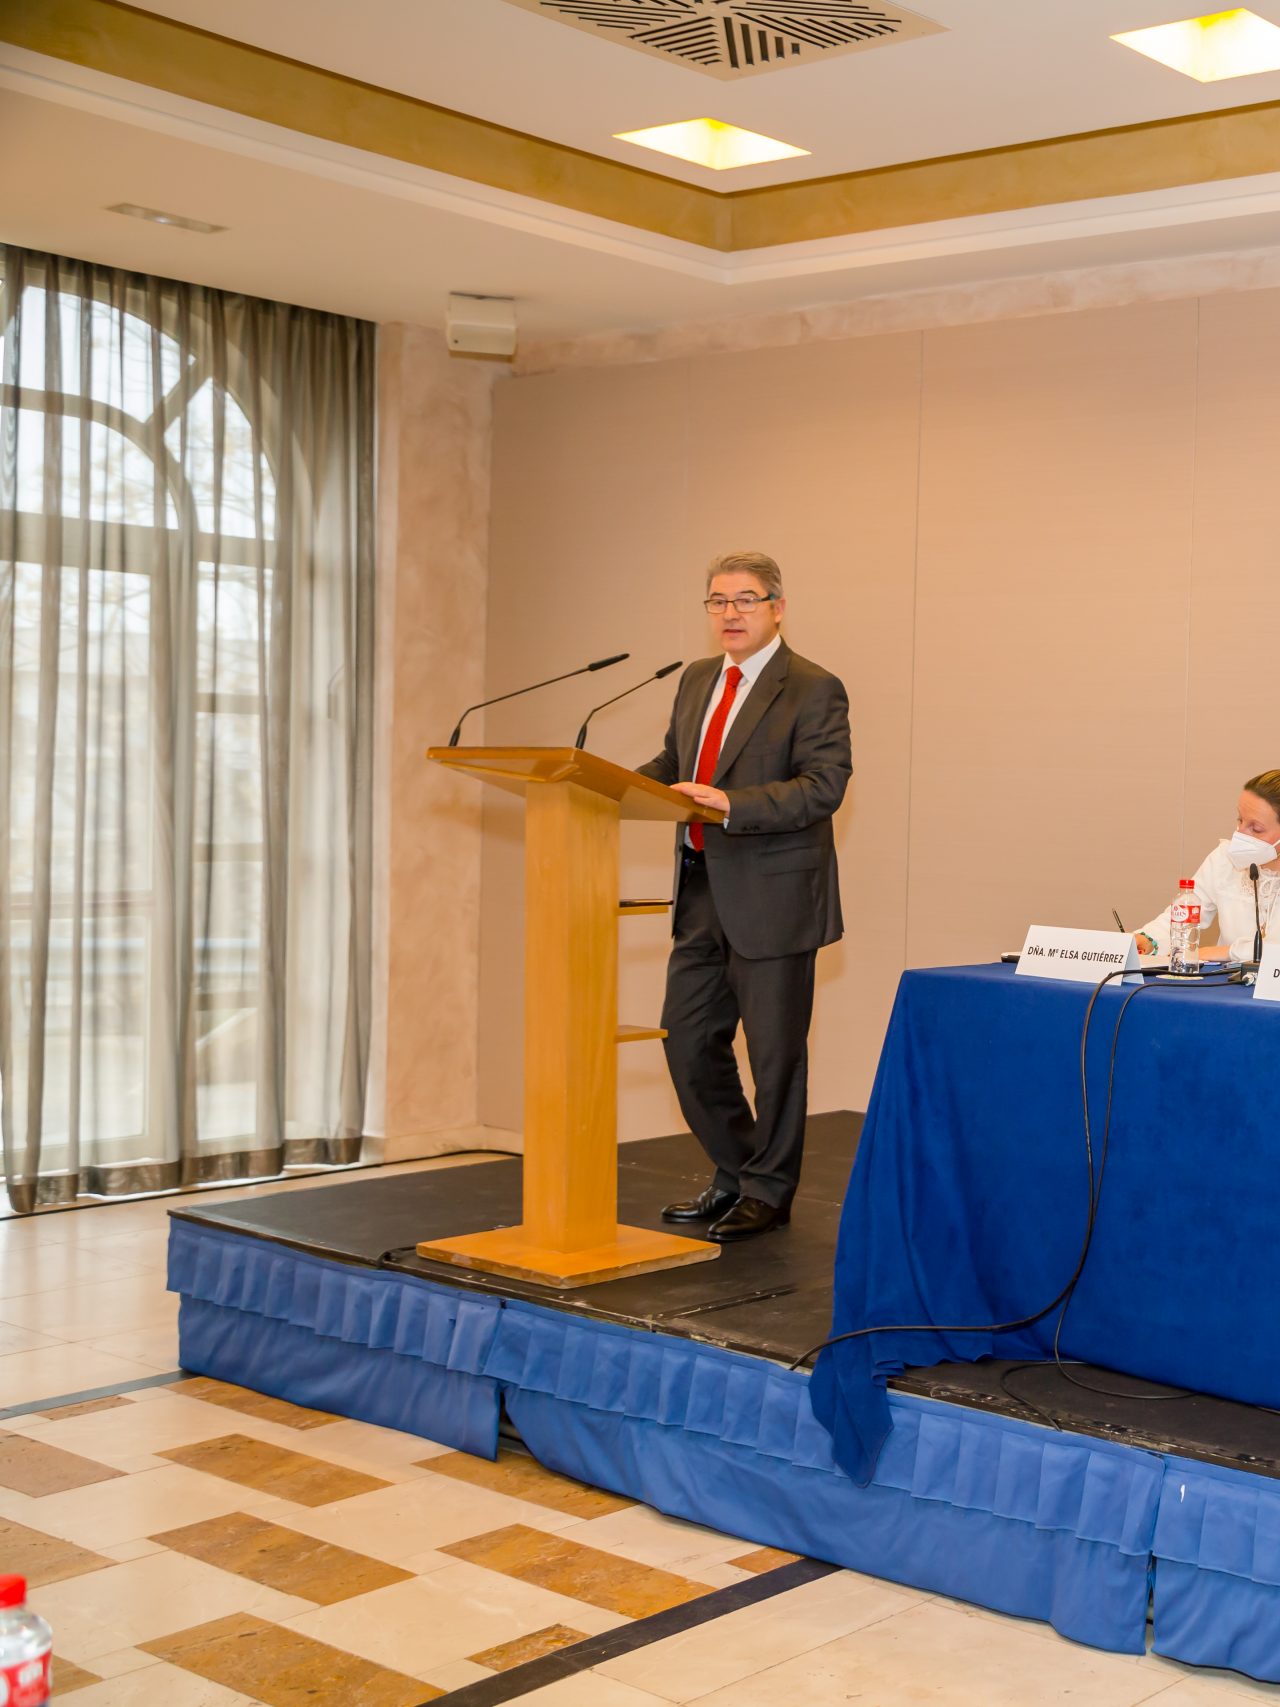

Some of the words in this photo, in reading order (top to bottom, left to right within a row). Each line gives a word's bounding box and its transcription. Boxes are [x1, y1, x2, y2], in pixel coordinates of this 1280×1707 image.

[1027, 945, 1046, 957] DÑA.
[1060, 949, 1079, 959] ELSA
[1081, 951, 1124, 963] GUTIÉRREZ
